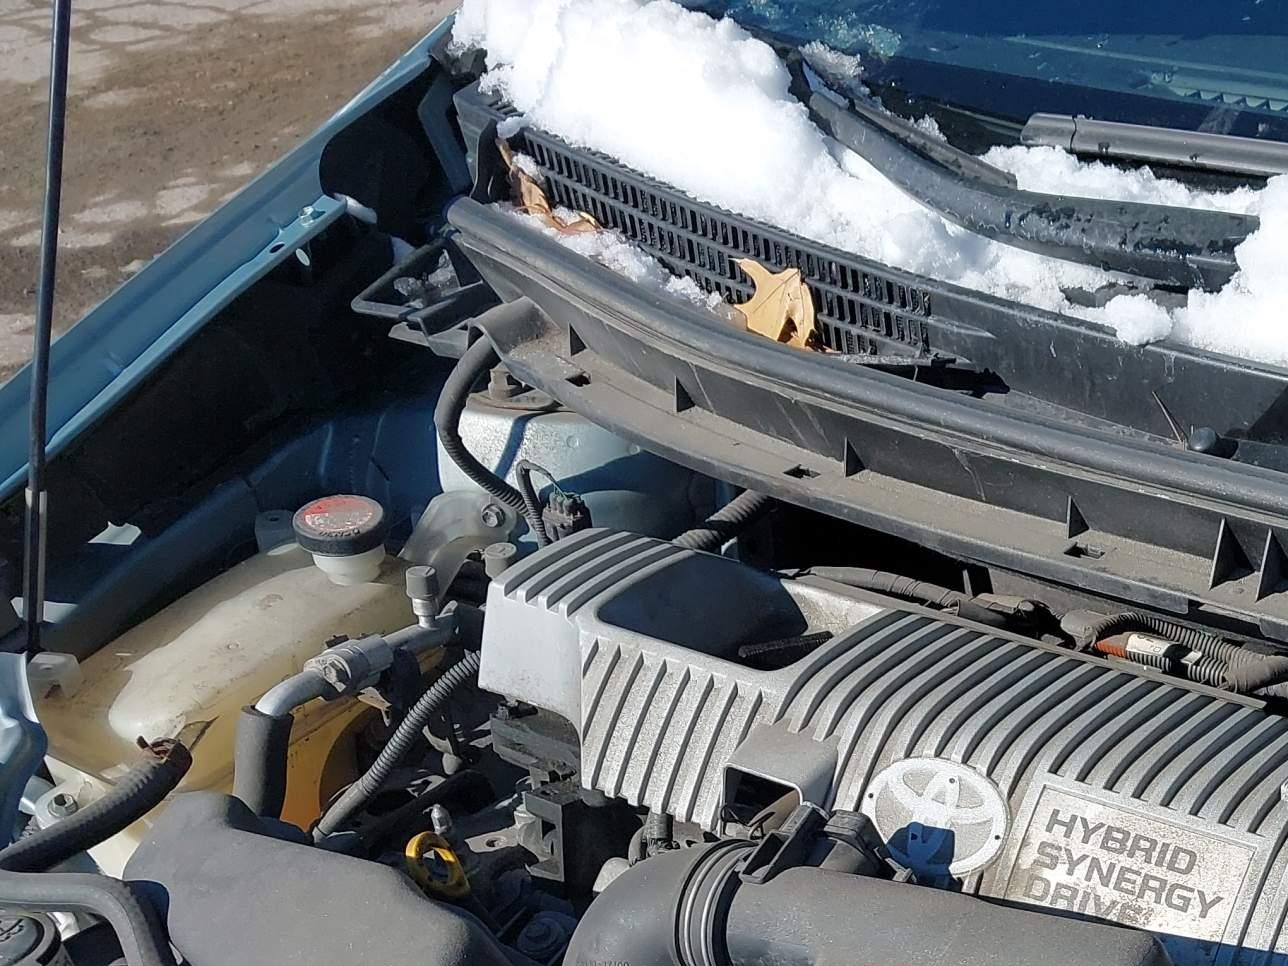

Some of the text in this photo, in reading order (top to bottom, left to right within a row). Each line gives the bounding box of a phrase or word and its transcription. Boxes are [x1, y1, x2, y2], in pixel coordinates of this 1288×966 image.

[1045, 808, 1198, 875] HYBRID
[1022, 874, 1144, 924] DRIVE
[1033, 841, 1225, 919] SYNERGY
